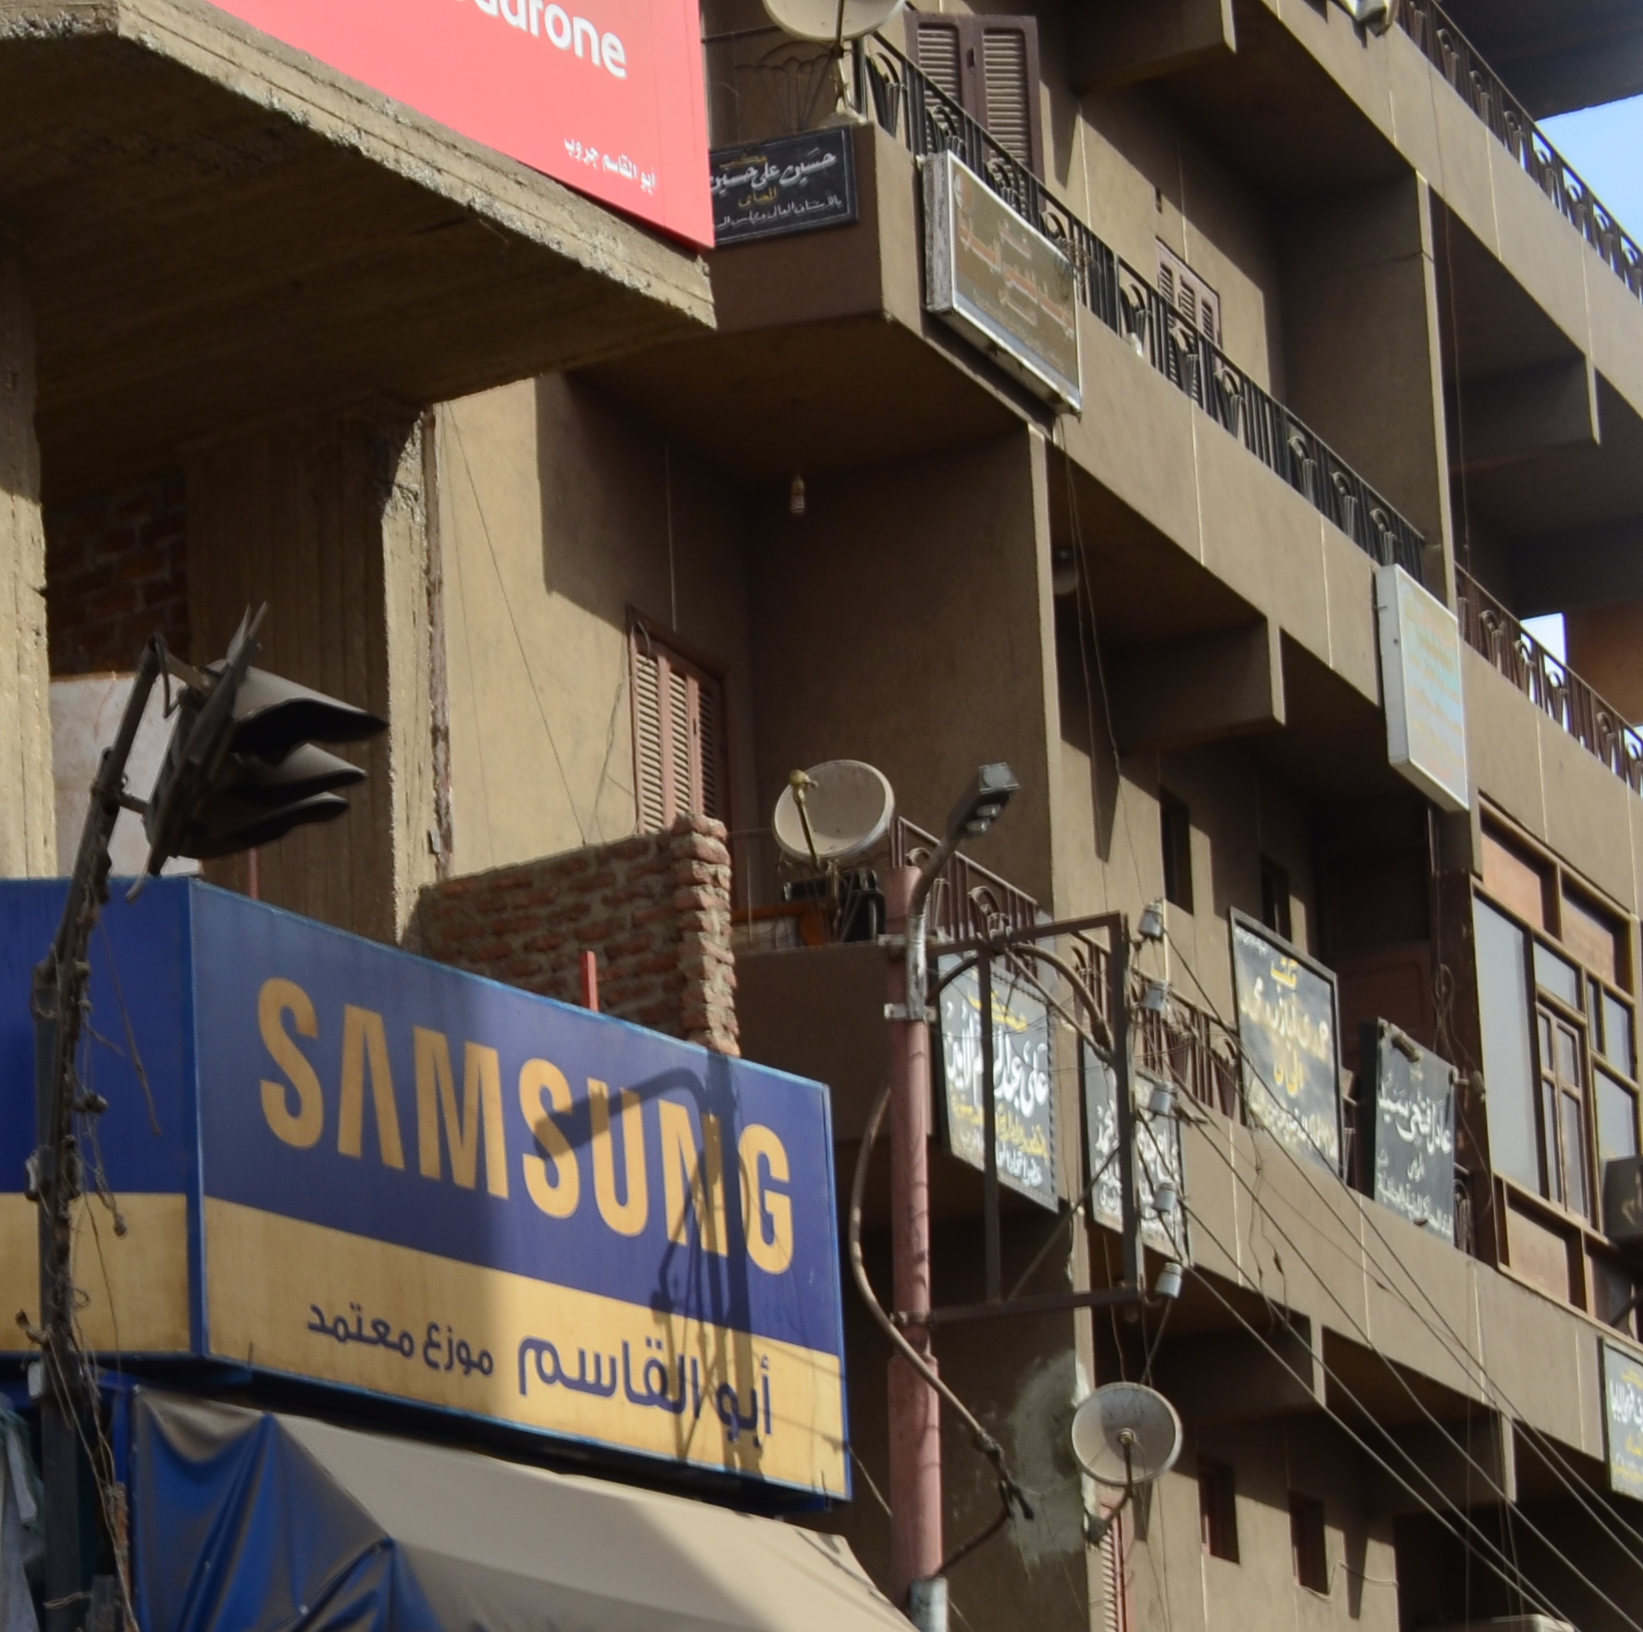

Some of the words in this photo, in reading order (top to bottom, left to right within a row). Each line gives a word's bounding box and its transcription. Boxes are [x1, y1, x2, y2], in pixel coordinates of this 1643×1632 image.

[455, 0, 627, 80] afone
[258, 976, 795, 1275] SAMSUNG
[307, 1302, 412, 1363] معتمد
[417, 1317, 495, 1377] موزع
[517, 1335, 703, 1434] القاسم
[716, 1352, 772, 1441] أبو
